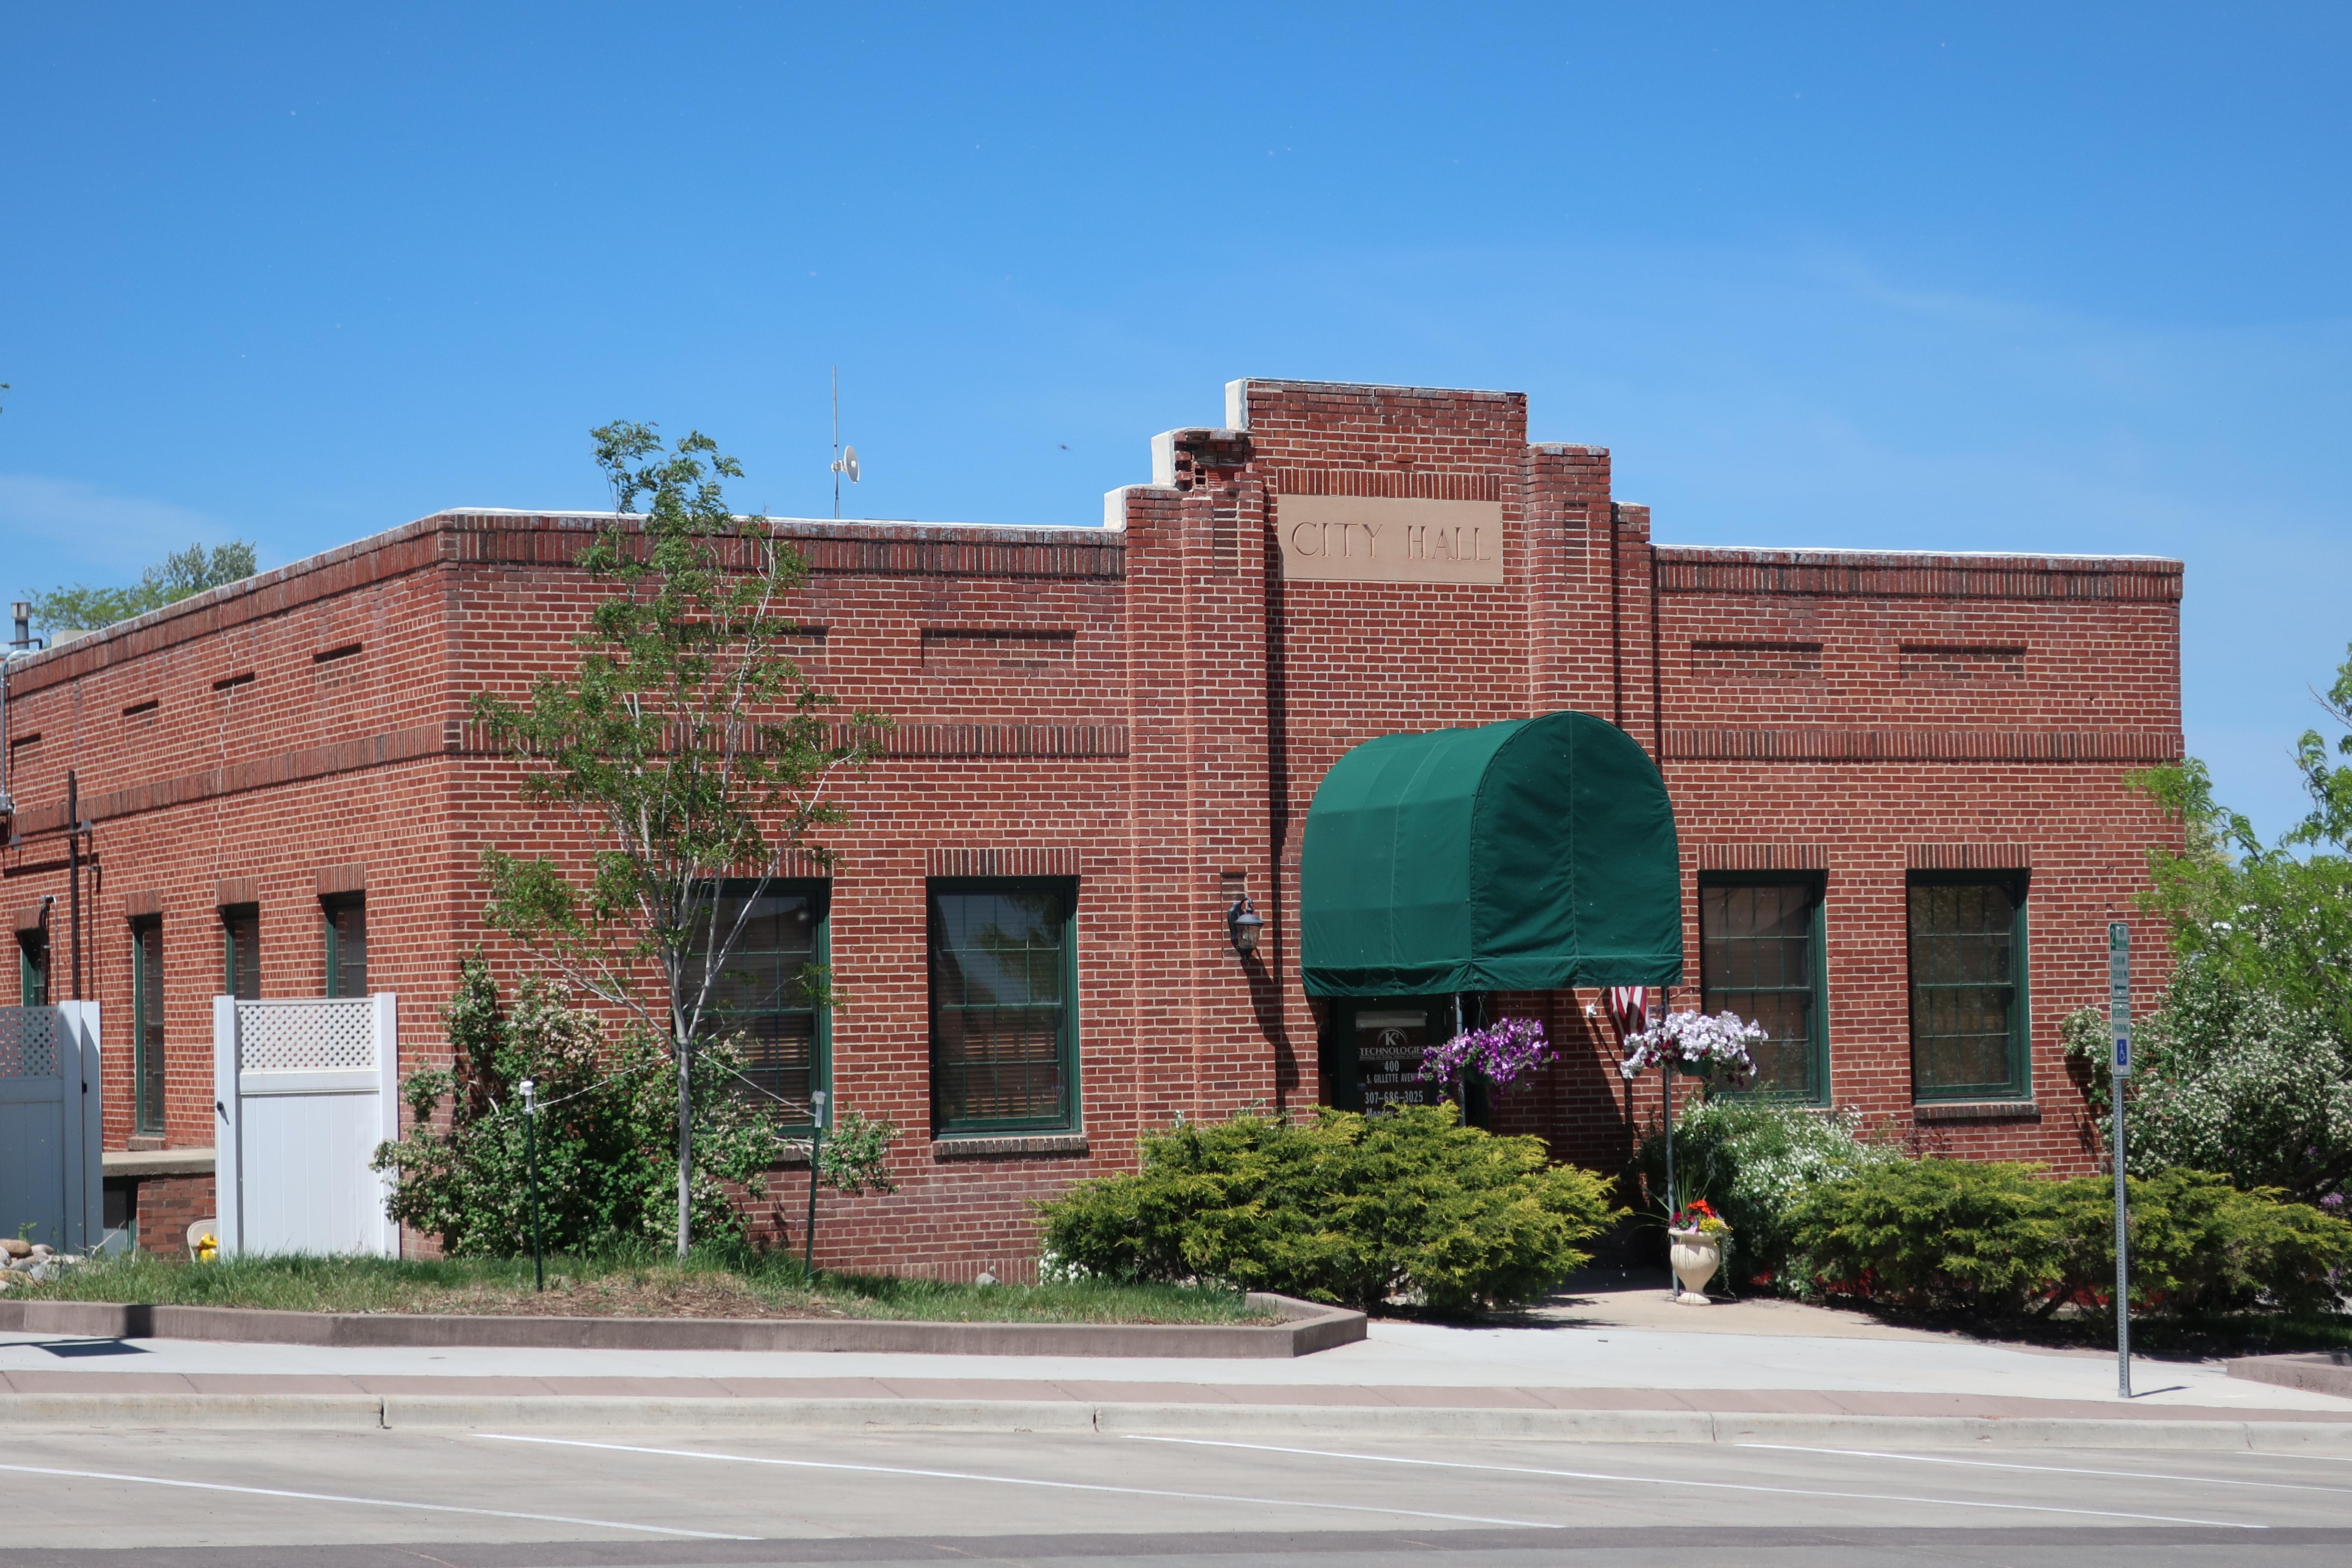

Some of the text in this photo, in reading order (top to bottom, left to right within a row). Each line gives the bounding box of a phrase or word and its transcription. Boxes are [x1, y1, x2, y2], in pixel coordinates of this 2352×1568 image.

[1292, 521, 1491, 560] CITY HALL
[1384, 1060, 1400, 1072] 400
[1366, 1074, 1372, 1084] S.
[1374, 1074, 1398, 1083] GILLETTE
[1365, 1091, 1424, 1104] 307-686-3025
